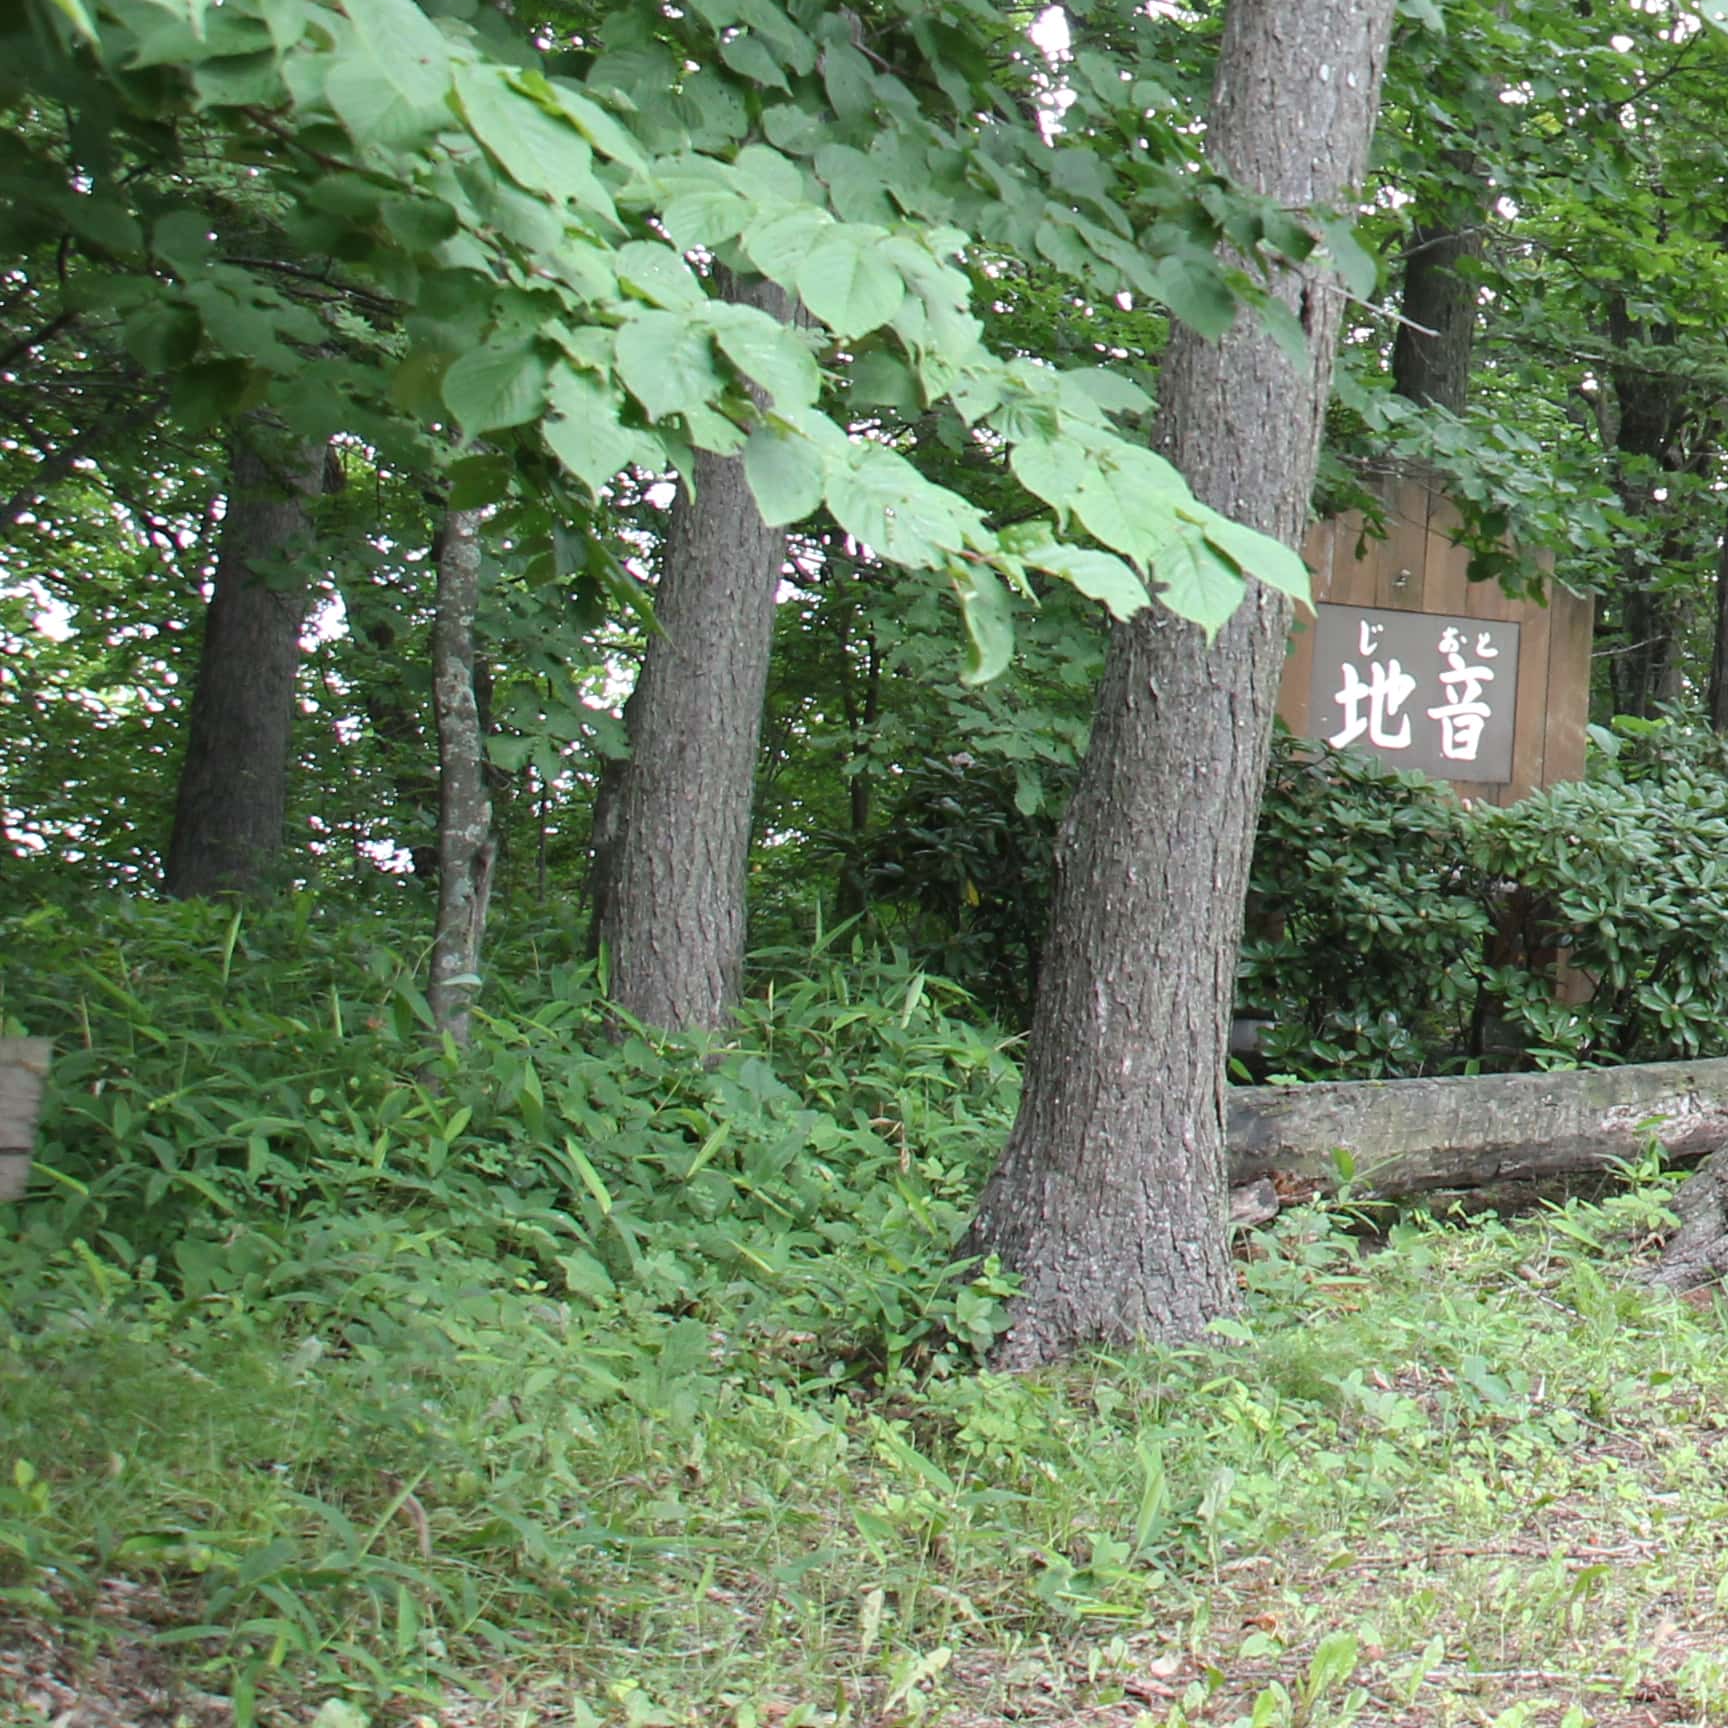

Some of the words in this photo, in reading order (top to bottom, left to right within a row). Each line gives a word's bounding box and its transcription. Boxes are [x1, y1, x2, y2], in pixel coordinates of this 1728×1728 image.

[1359, 619, 1384, 656] じ
[1438, 626, 1499, 658] おと
[1328, 653, 1495, 760] 地音
